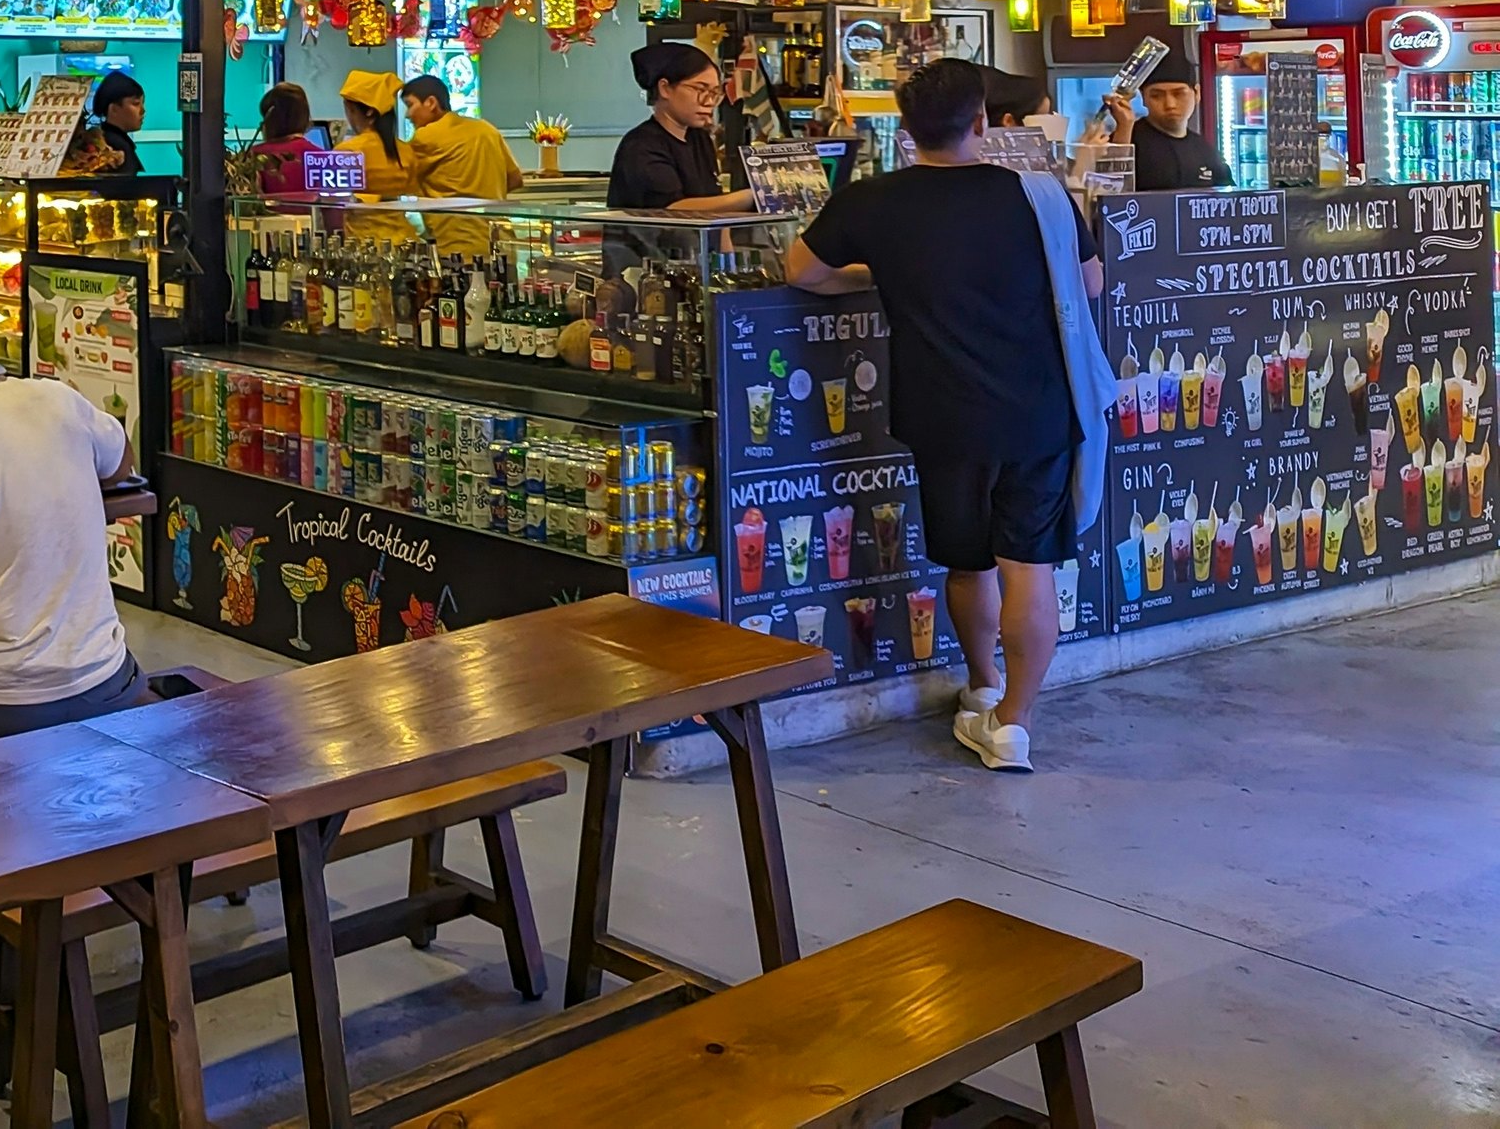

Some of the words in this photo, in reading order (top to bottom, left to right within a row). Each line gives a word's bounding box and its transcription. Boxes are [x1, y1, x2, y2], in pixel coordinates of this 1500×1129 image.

[1474, 43, 1492, 52] ICE
[307, 155, 328, 168] Buy
[335, 155, 357, 166] Get
[308, 169, 362, 188] FREE
[1188, 197, 1237, 219] HAPPY
[1239, 195, 1279, 216] HOUR
[1408, 183, 1484, 233] FREE
[1327, 203, 1351, 233] BUY
[1355, 201, 1362, 232] 1
[1365, 200, 1389, 230] GET
[1391, 199, 1399, 229] 1
[1128, 233, 1143, 249] FIX
[1142, 227, 1153, 247] IT
[1196, 259, 1294, 292] SPECIAL
[1302, 248, 1416, 283] COCKTAILS
[55, 276, 79, 292] LOCAL
[79, 279, 103, 295] DRINK
[1272, 296, 1305, 320] RUM
[1344, 291, 1386, 311] WHISKY
[1423, 289, 1467, 313] VODKA
[1113, 301, 1179, 329] TEQUILA
[1421, 334, 1438, 344] FORGET
[1397, 343, 1413, 353] GOOD
[811, 431, 862, 452] SCREWDRIVER
[1174, 437, 1205, 448] CONFUSING
[744, 446, 774, 457] MOJITO
[1114, 444, 1125, 454] THE
[1269, 451, 1319, 476] BRANDY
[1123, 464, 1153, 490] GIN
[731, 474, 827, 508] NATIONAL
[1169, 489, 1187, 499] VIOLET
[1171, 499, 1184, 508] EYES
[276, 501, 350, 546] Tropical
[357, 512, 437, 572] Cocktails
[1427, 531, 1444, 542] GREEN
[1448, 528, 1464, 539] ASTRO
[1407, 537, 1418, 547] RED
[1428, 542, 1444, 553] PEARL
[1450, 539, 1461, 549] BOY
[1402, 547, 1424, 559] DRAGON
[636, 576, 660, 594] NEW
[662, 568, 712, 590] COCKTAILS
[660, 590, 678, 601] THIS
[679, 584, 713, 600] SUMMER
[734, 594, 758, 606] BLOODY
[758, 591, 776, 602] MARY
[1121, 605, 1130, 614] FLY
[1130, 603, 1139, 612] ON
[1120, 614, 1130, 624] THE
[1130, 612, 1141, 622] SKY
[1073, 629, 1089, 640] SOUR
[895, 665, 907, 673] SEX
[907, 663, 917, 671] ON
[930, 656, 949, 667] BEACH
[823, 678, 837, 686] YOU
[848, 671, 874, 681] SANGRIA
